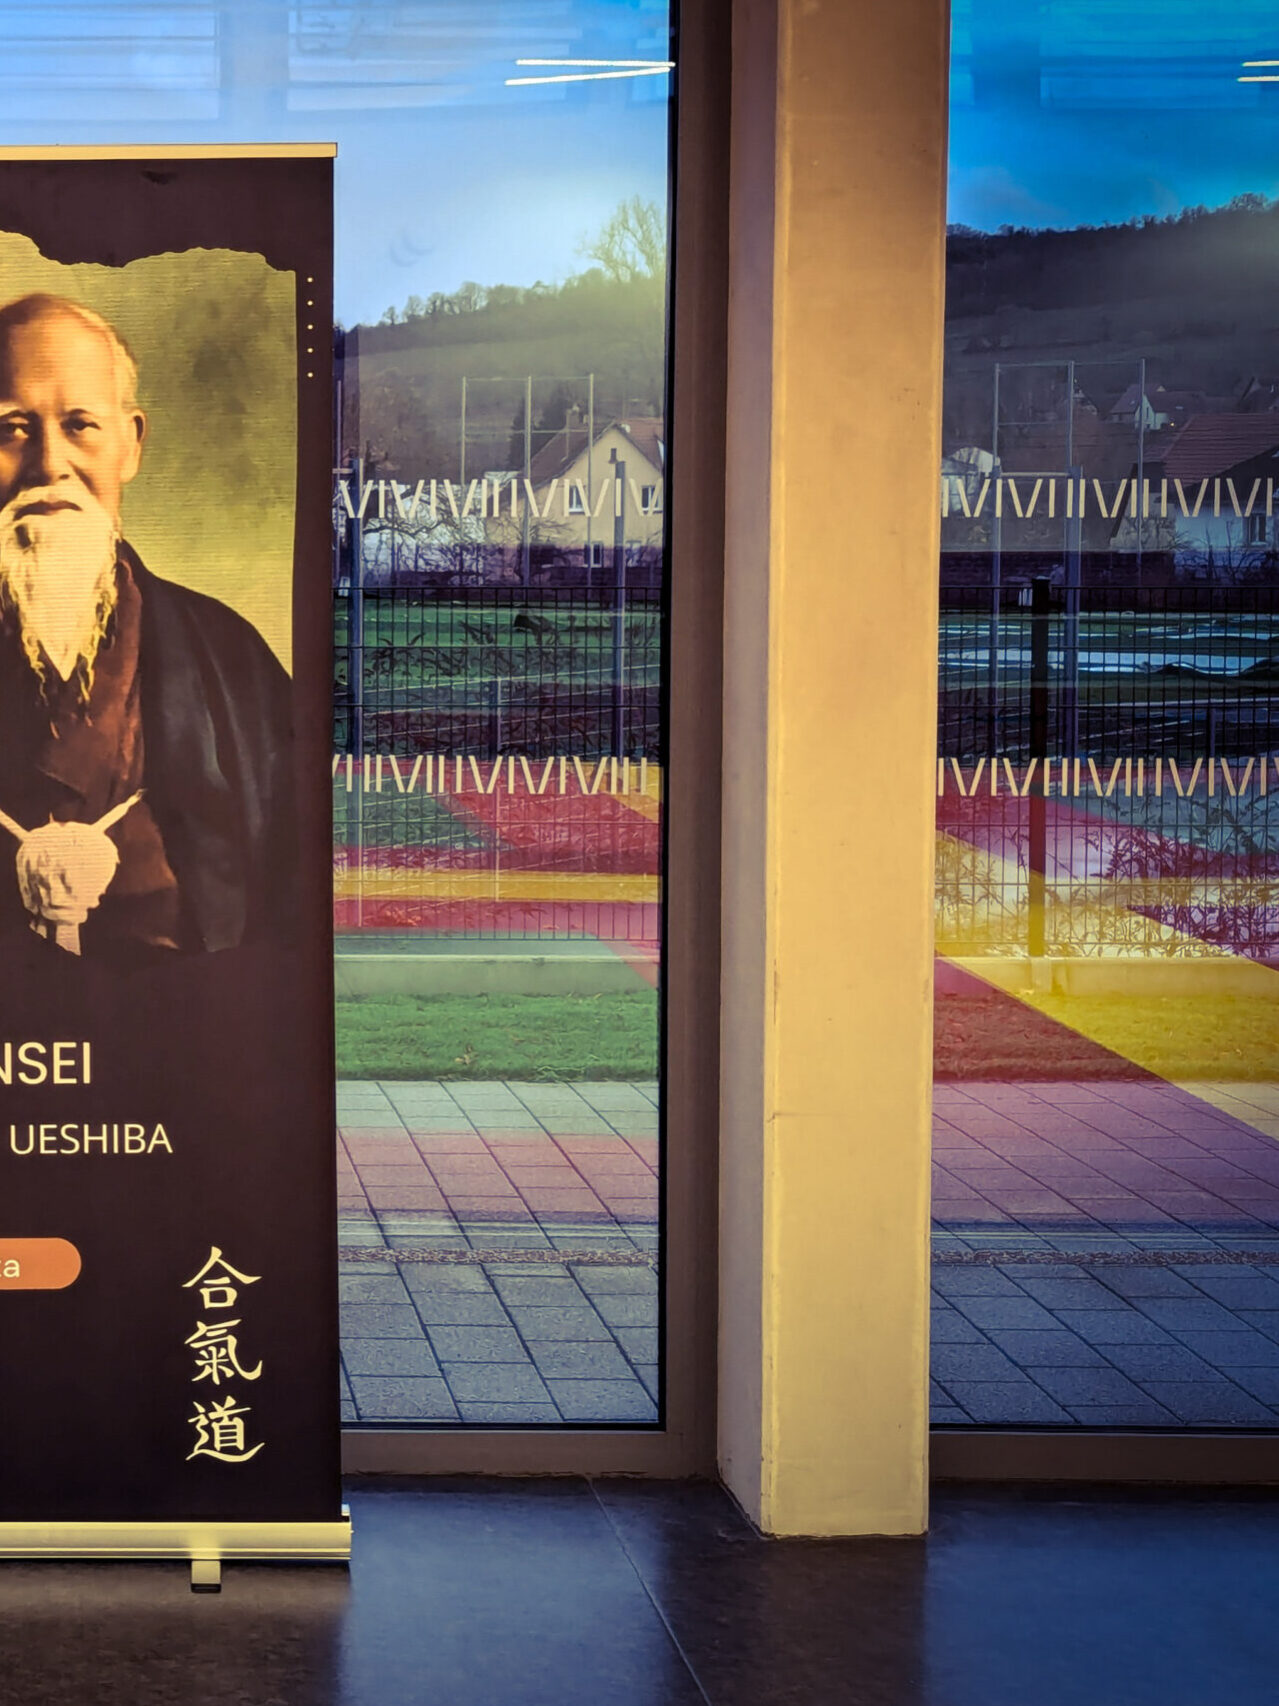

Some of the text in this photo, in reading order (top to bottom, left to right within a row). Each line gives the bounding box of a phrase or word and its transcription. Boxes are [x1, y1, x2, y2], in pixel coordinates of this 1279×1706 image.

[9, 1123, 173, 1155] UESHIBA
[181, 1245, 265, 1463] 合氣道
